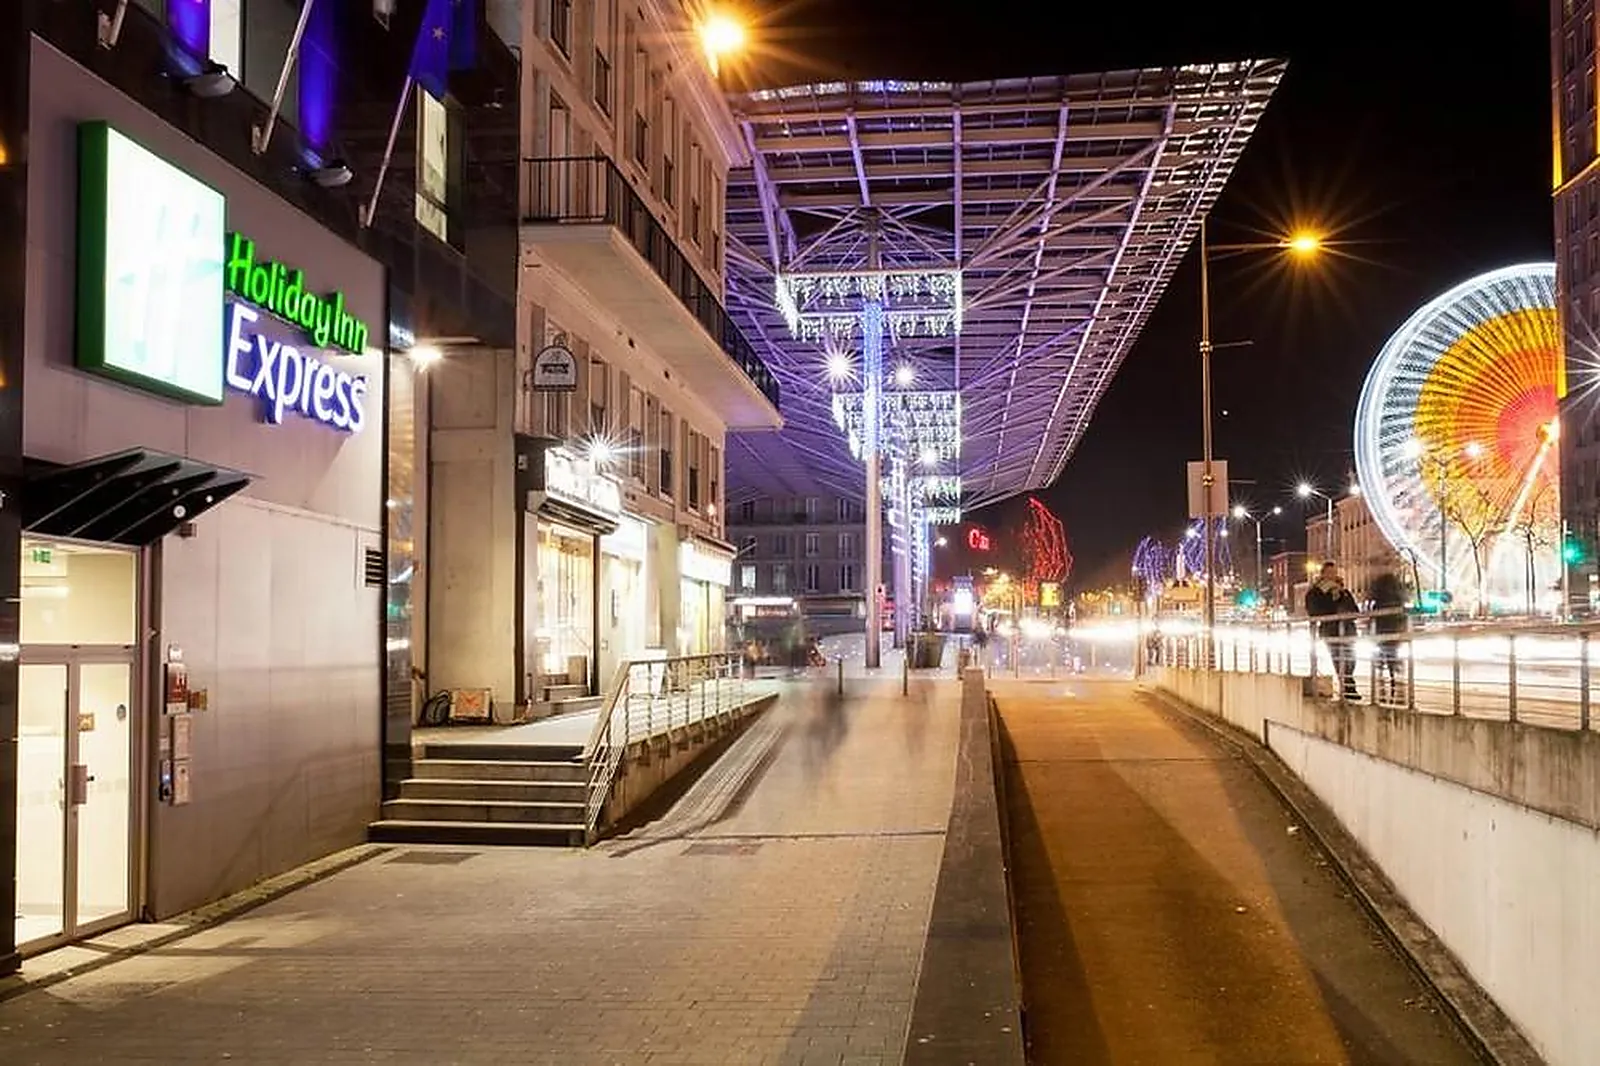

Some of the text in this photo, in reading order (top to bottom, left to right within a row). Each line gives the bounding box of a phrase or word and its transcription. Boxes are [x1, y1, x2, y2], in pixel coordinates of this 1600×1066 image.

[227, 231, 368, 356] Holiday Inn
[226, 302, 369, 435] Express
